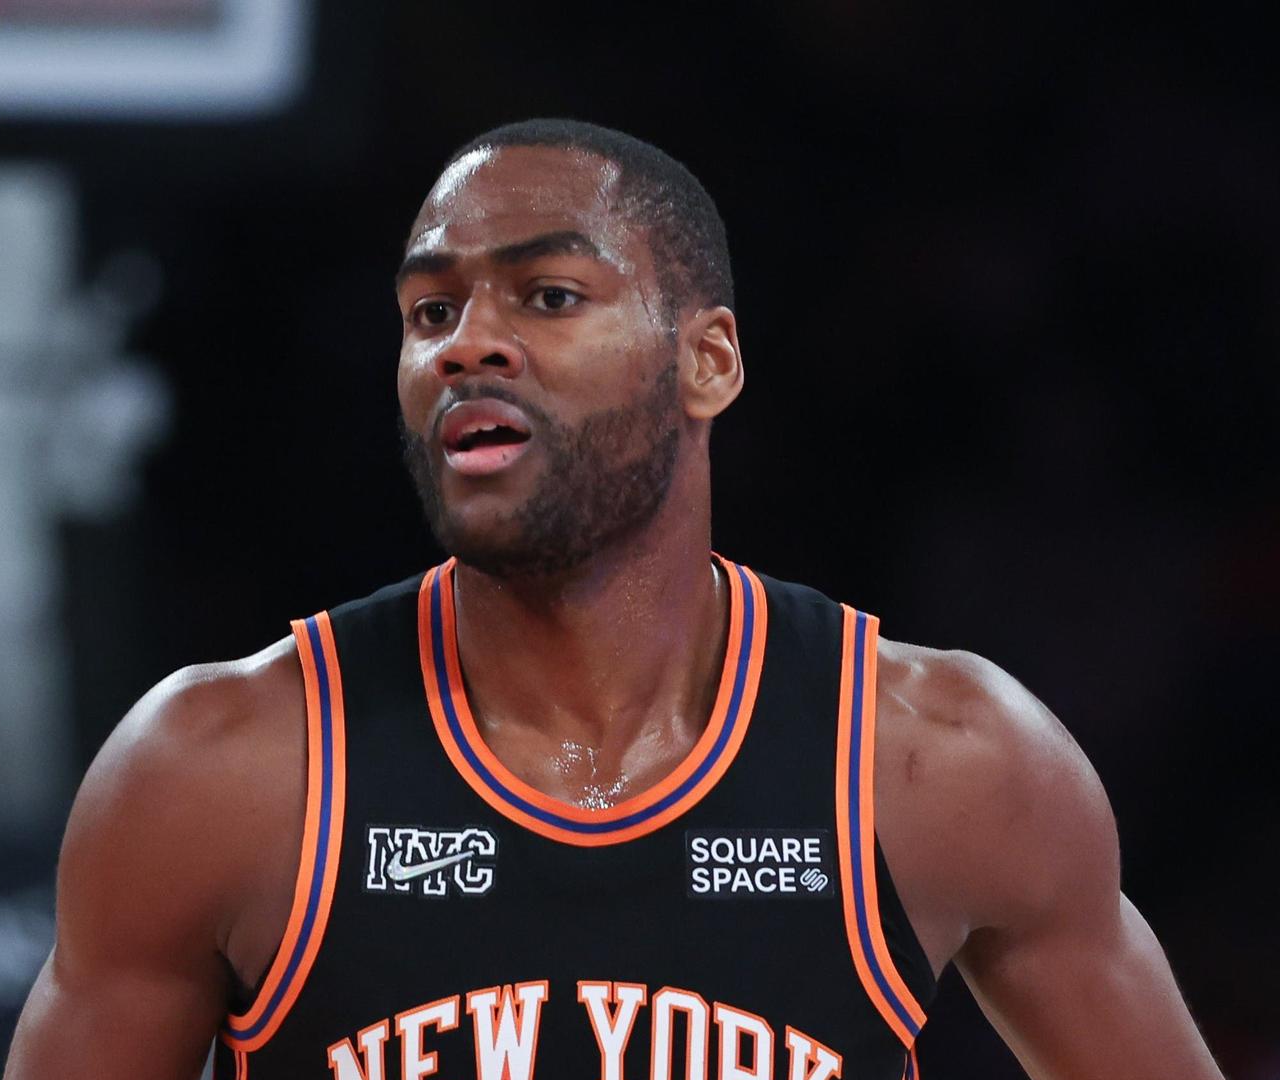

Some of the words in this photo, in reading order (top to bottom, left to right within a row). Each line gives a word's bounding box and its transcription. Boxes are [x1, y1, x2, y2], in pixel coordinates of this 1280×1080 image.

[366, 827, 496, 896] NYC
[691, 837, 821, 864] SQUARE
[691, 867, 797, 893] SPACE
